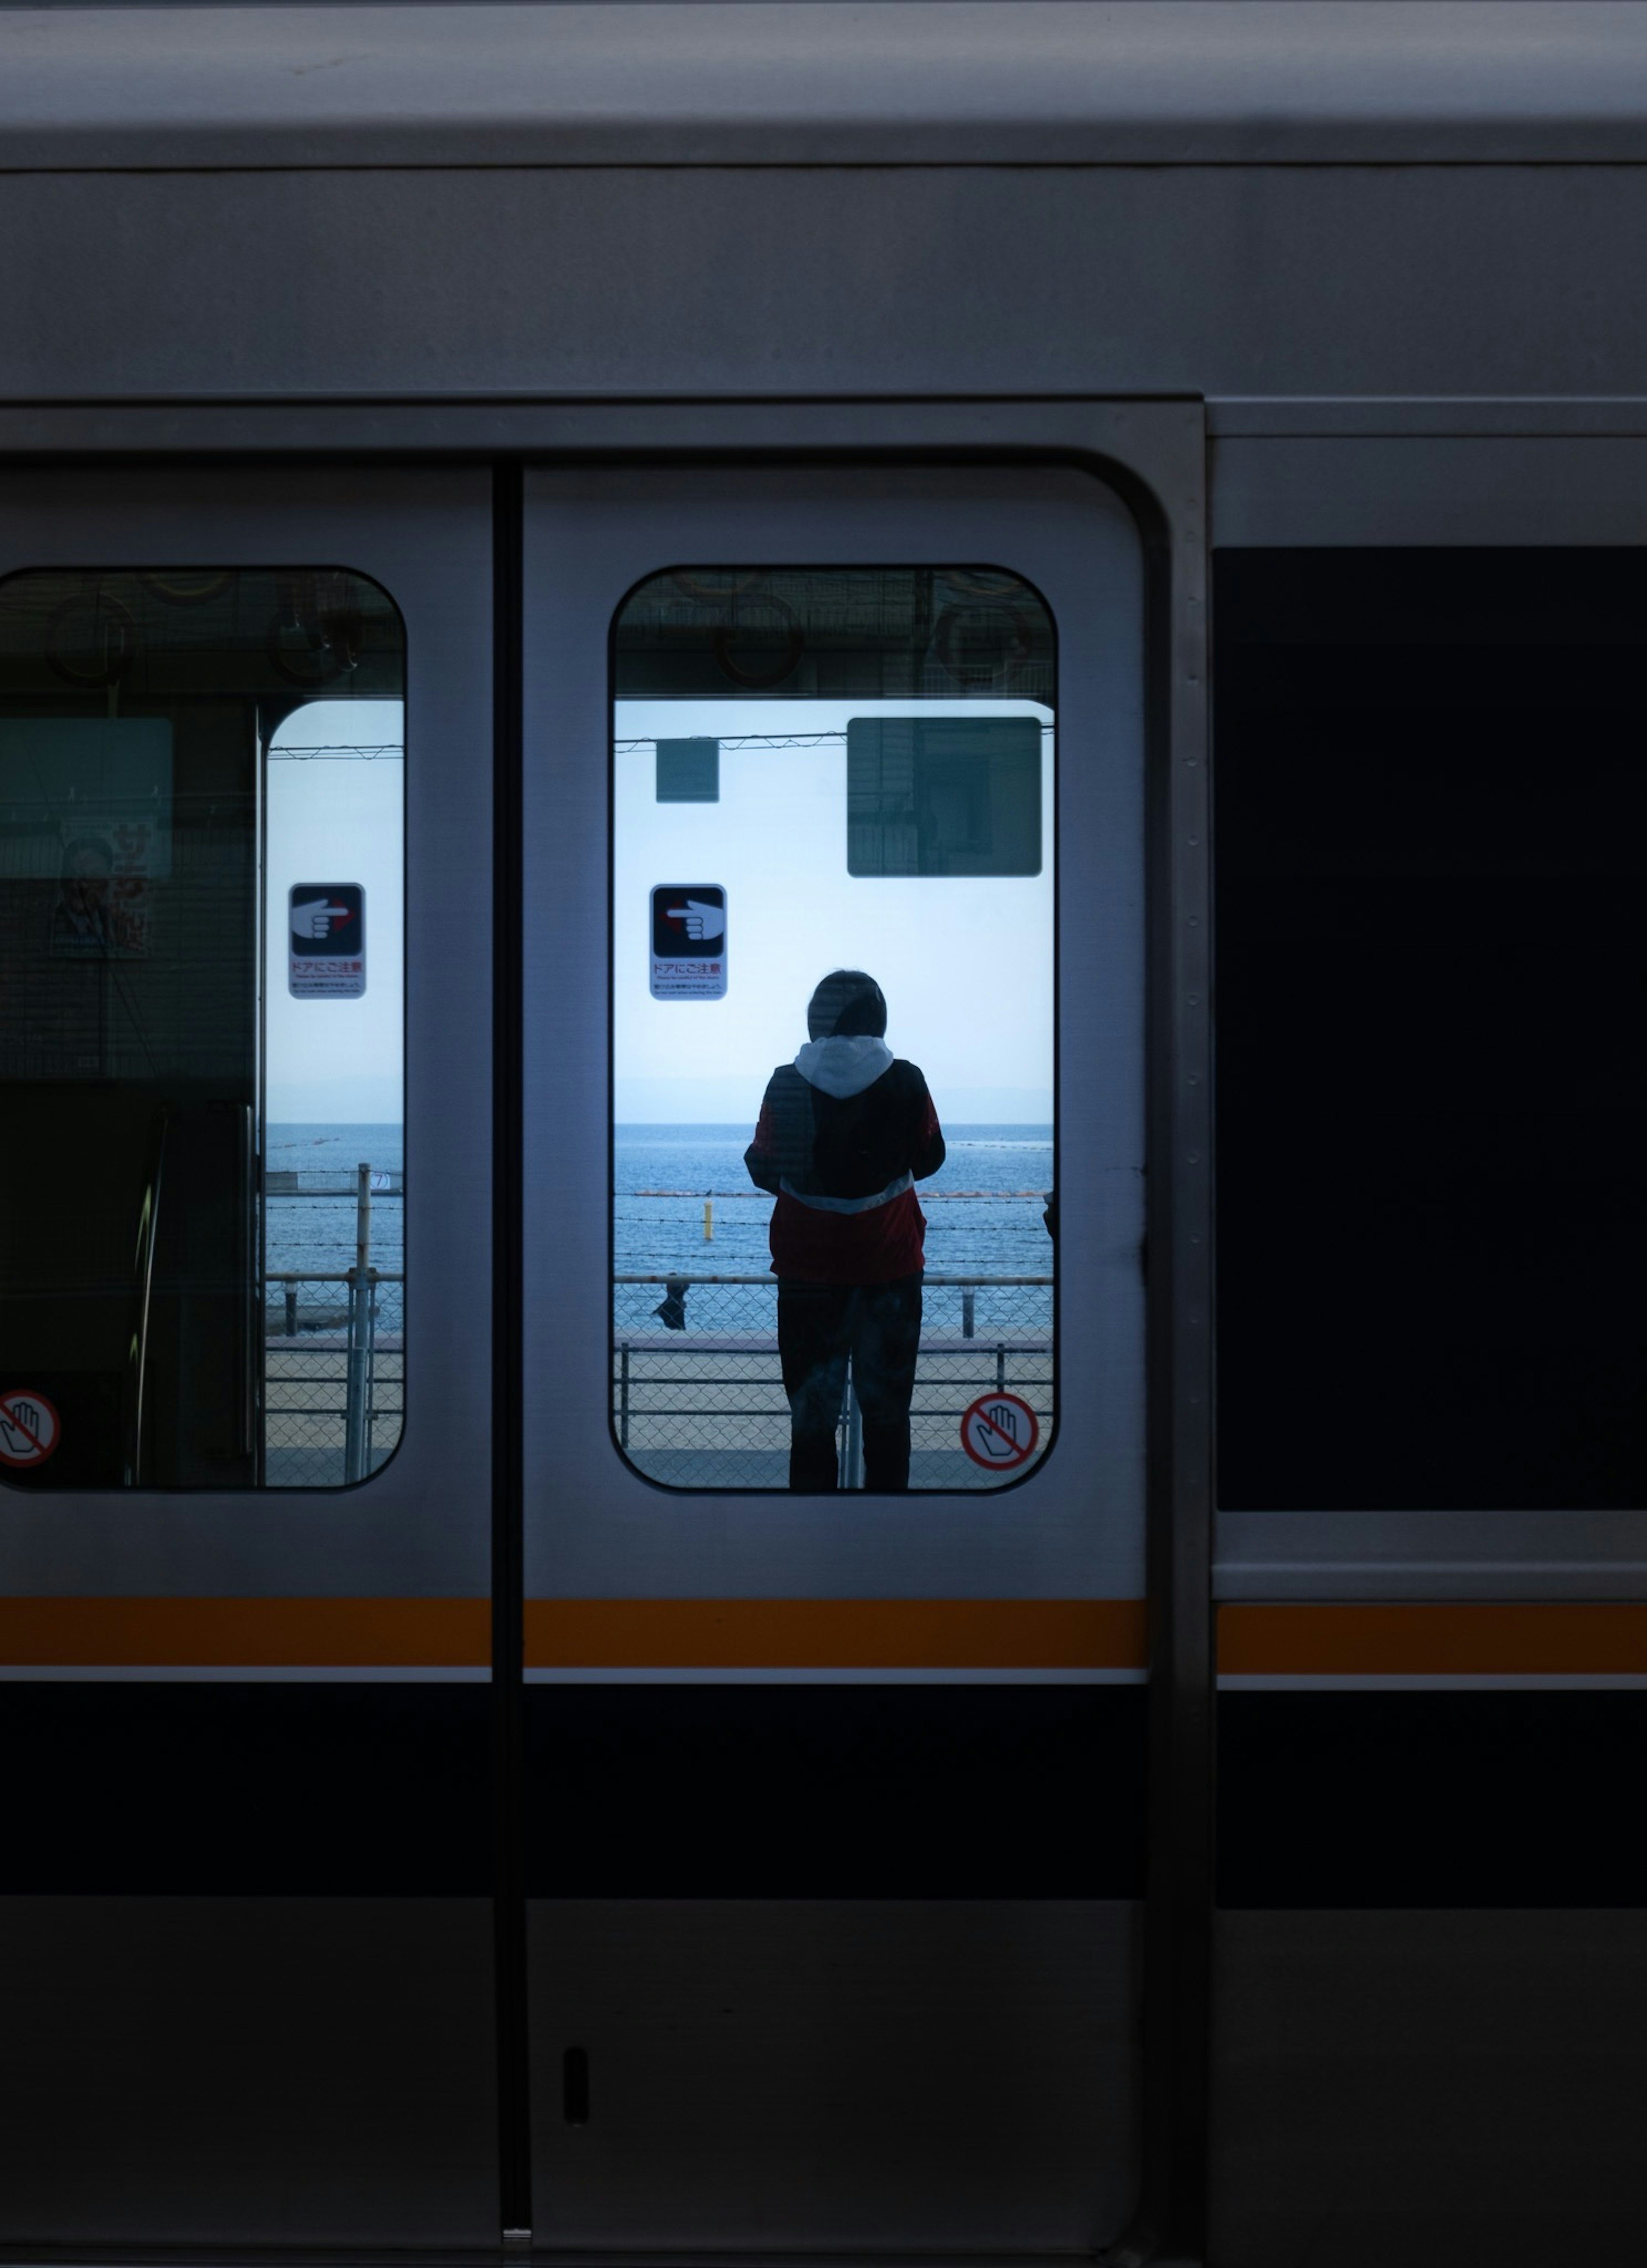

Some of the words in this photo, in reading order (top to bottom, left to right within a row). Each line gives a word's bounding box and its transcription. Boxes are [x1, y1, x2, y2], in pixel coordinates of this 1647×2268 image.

[655, 963, 721, 974] ドアにご注意
[374, 1174, 383, 1187] 7
